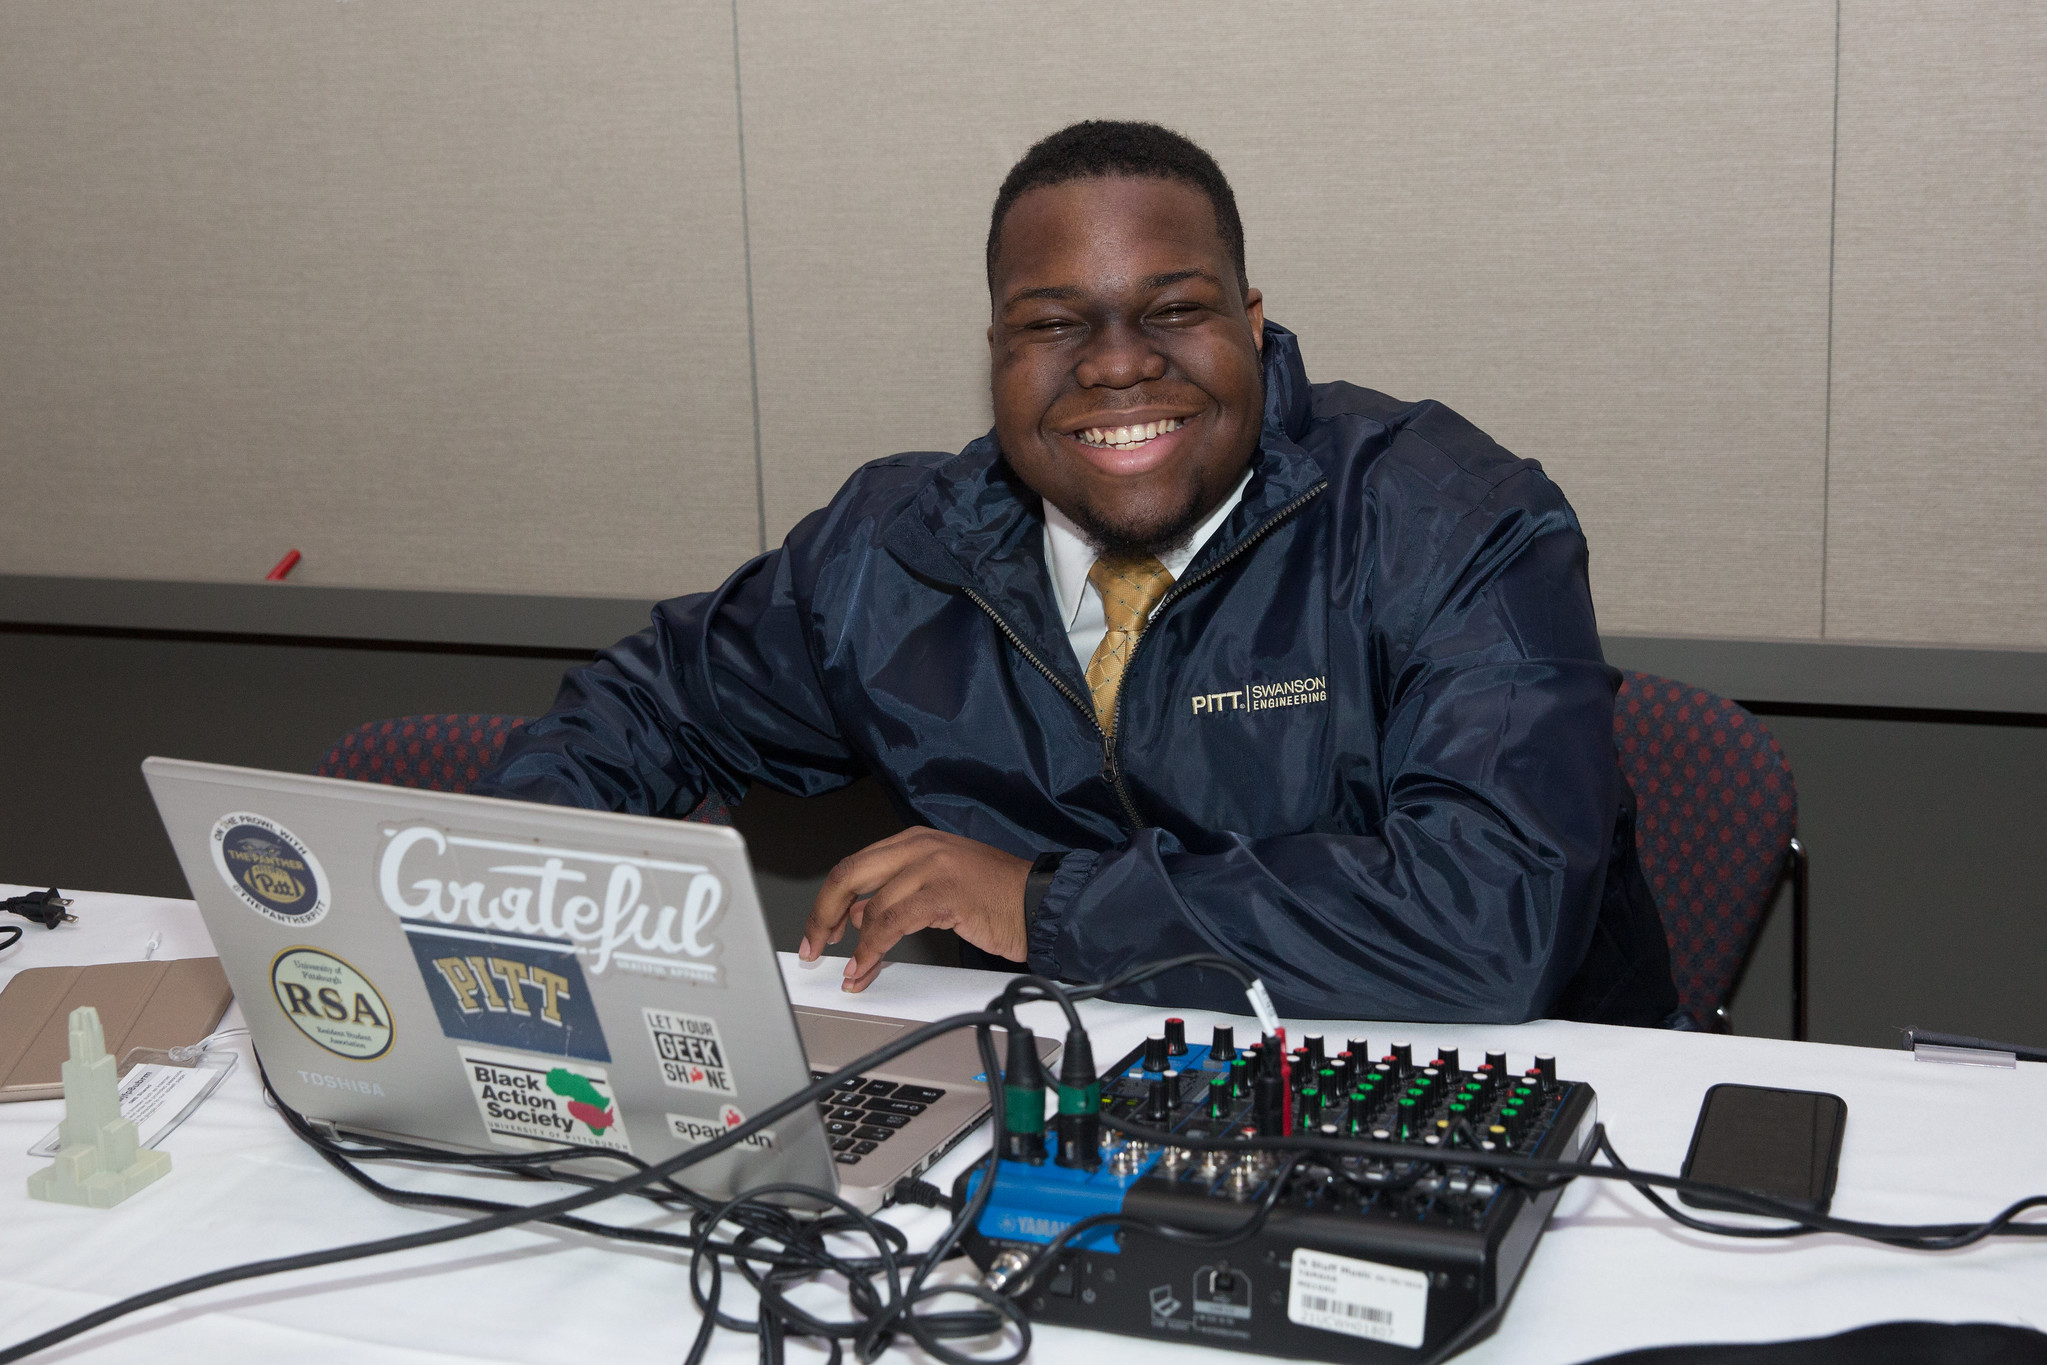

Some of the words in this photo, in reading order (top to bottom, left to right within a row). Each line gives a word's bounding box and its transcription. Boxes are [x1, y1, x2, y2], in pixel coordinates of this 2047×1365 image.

[1252, 676, 1326, 699] SWANSON
[1253, 691, 1327, 711] ENGINEERING
[1191, 691, 1243, 714] PITT
[214, 827, 224, 842] ON
[238, 815, 274, 831] PROWL
[280, 829, 307, 855] WITH
[252, 852, 305, 871] PANTHER
[255, 873, 295, 897] Pitt
[380, 826, 722, 974] Grateful
[279, 981, 388, 1029] RSA
[432, 956, 571, 1027] PITT
[647, 1013, 671, 1030] LET
[676, 1018, 714, 1037] YOUR
[657, 1033, 723, 1068] GEEK
[297, 1070, 385, 1097] TOSHIBA
[474, 1066, 541, 1092] Black
[663, 1062, 731, 1091] SHNE
[481, 1084, 557, 1111] Action
[486, 1101, 574, 1133] Society
[487, 1120, 546, 1137] UNIVERSITY
[548, 1130, 562, 1140] OF
[565, 1134, 629, 1151] PITTSBURGH
[1017, 1215, 1082, 1241] YAMA
